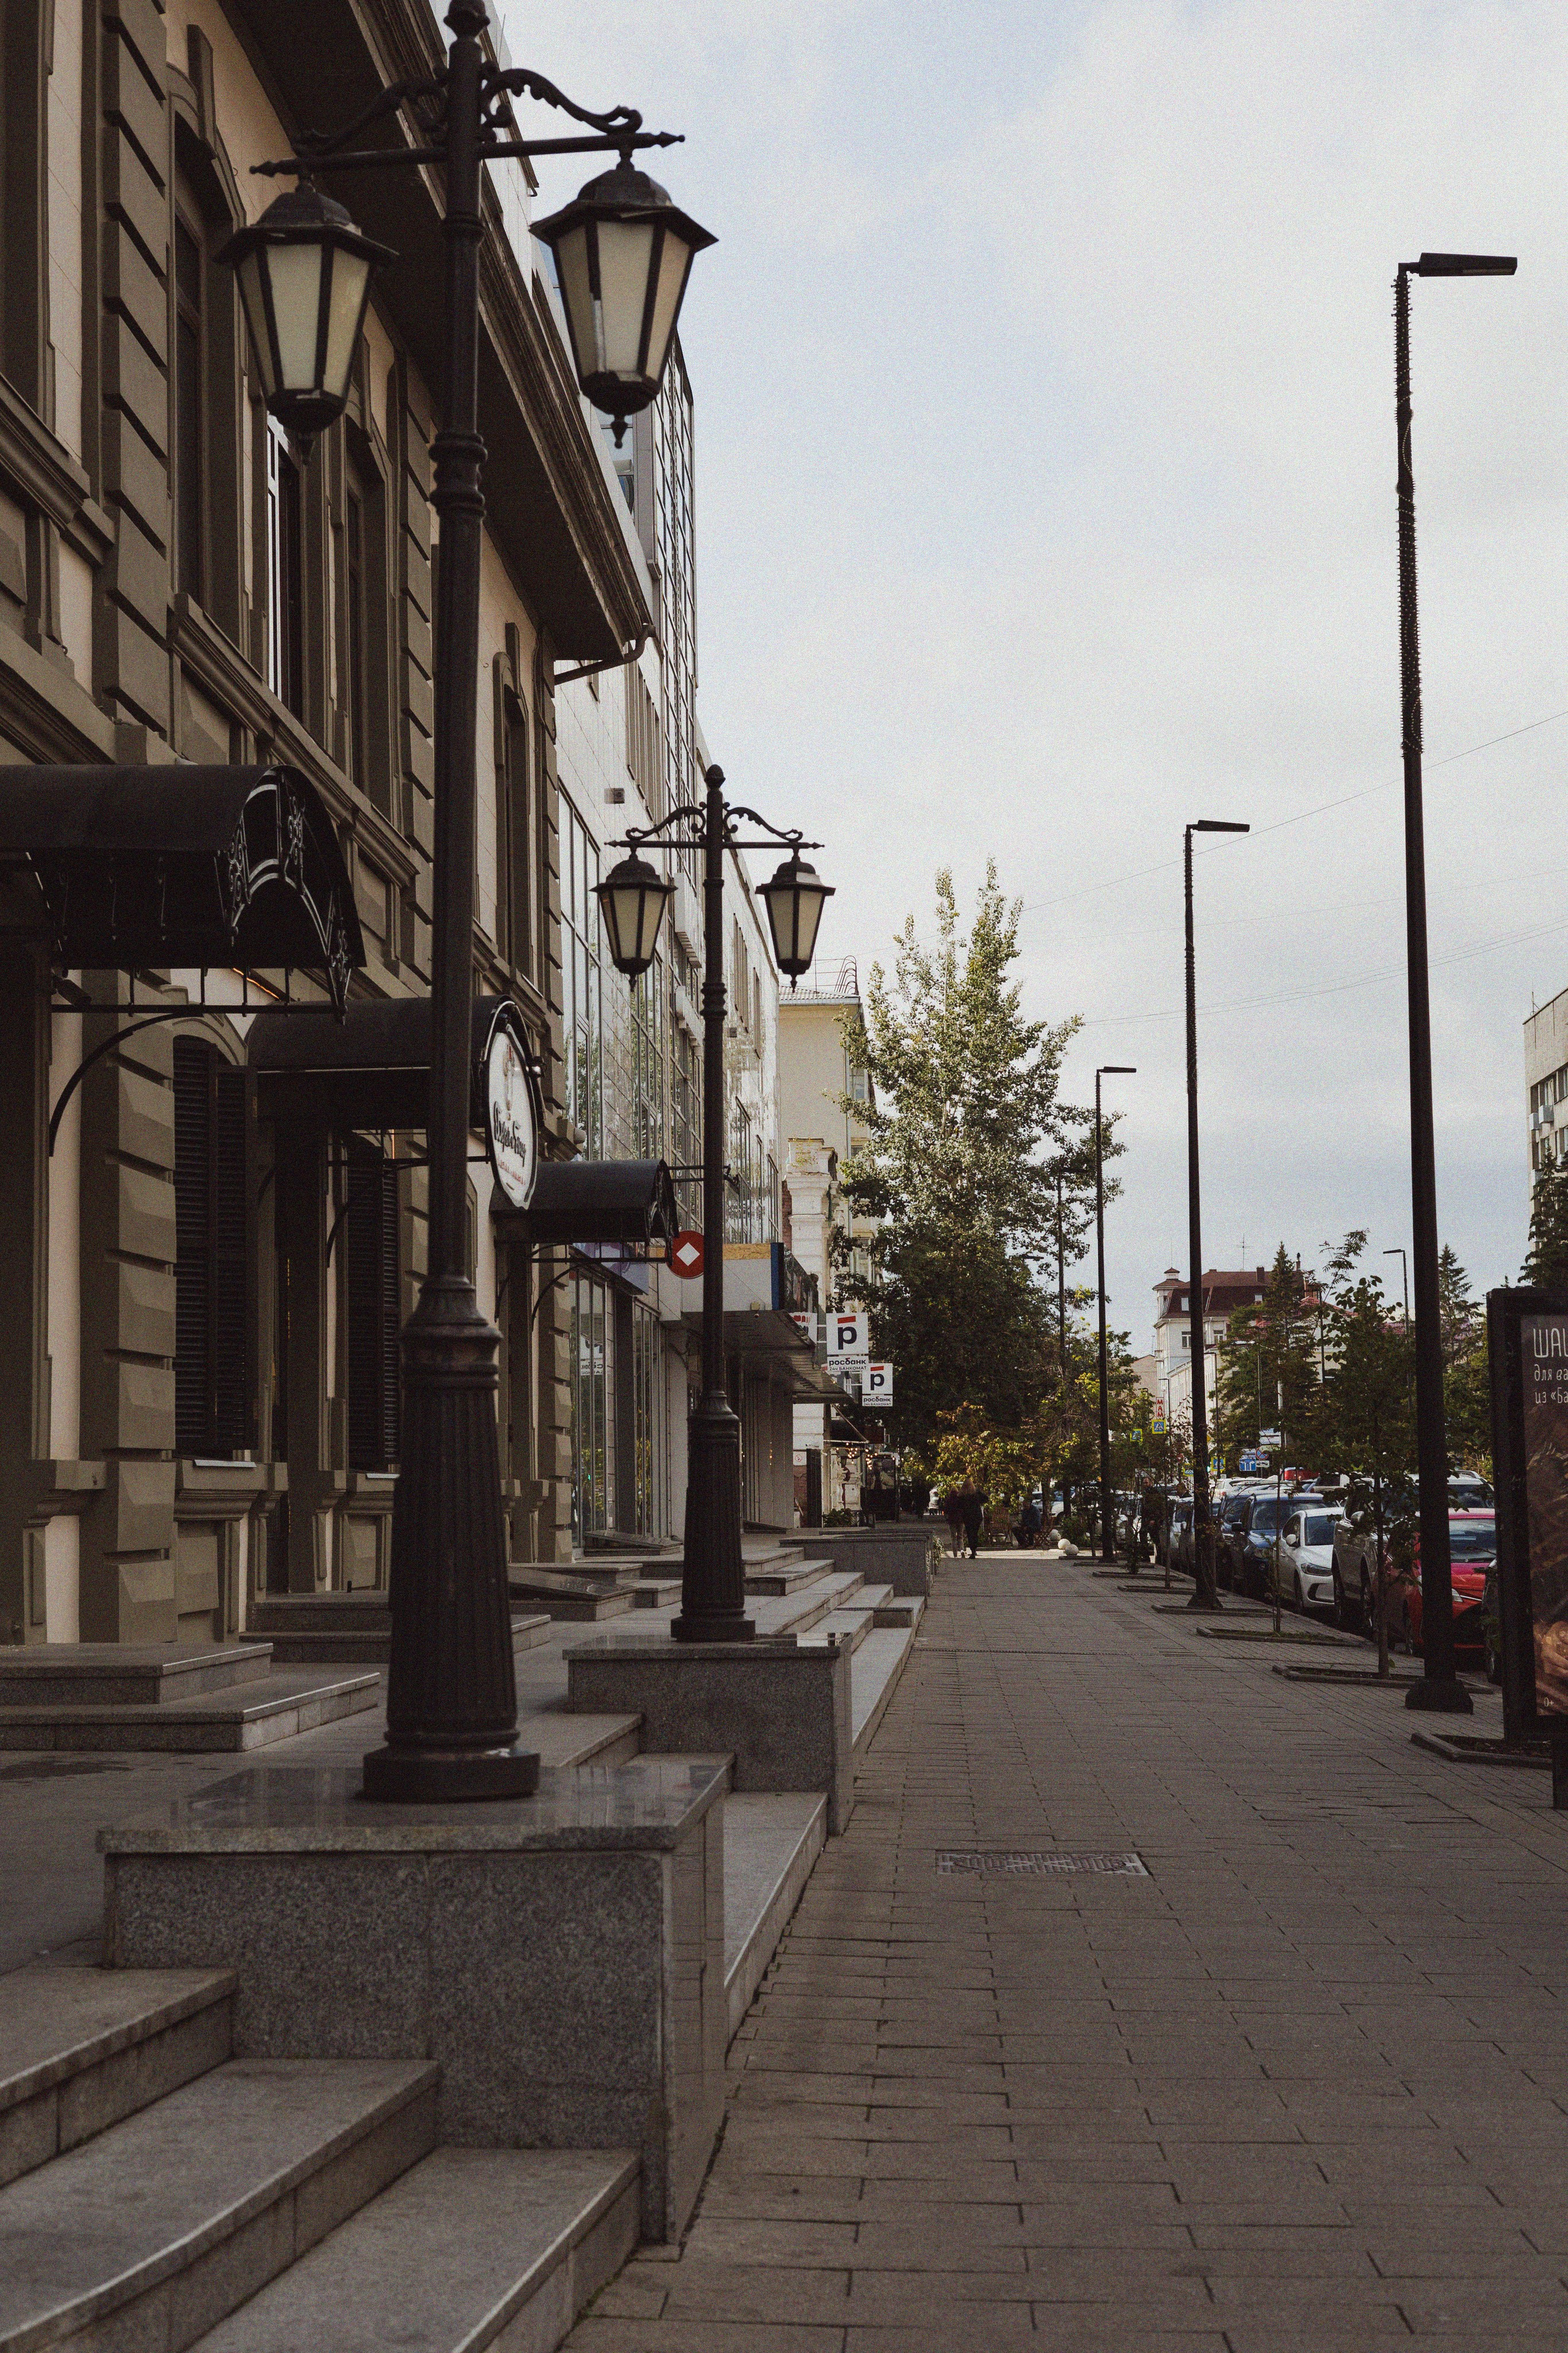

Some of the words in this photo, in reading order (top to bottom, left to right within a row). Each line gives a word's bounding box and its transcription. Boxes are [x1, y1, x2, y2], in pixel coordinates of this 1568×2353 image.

[829, 1357, 867, 1367] росбанк
[1534, 1364, 1552, 1381] для
[1535, 1391, 1547, 1403] из
[1544, 1697, 1555, 1707] 0+
